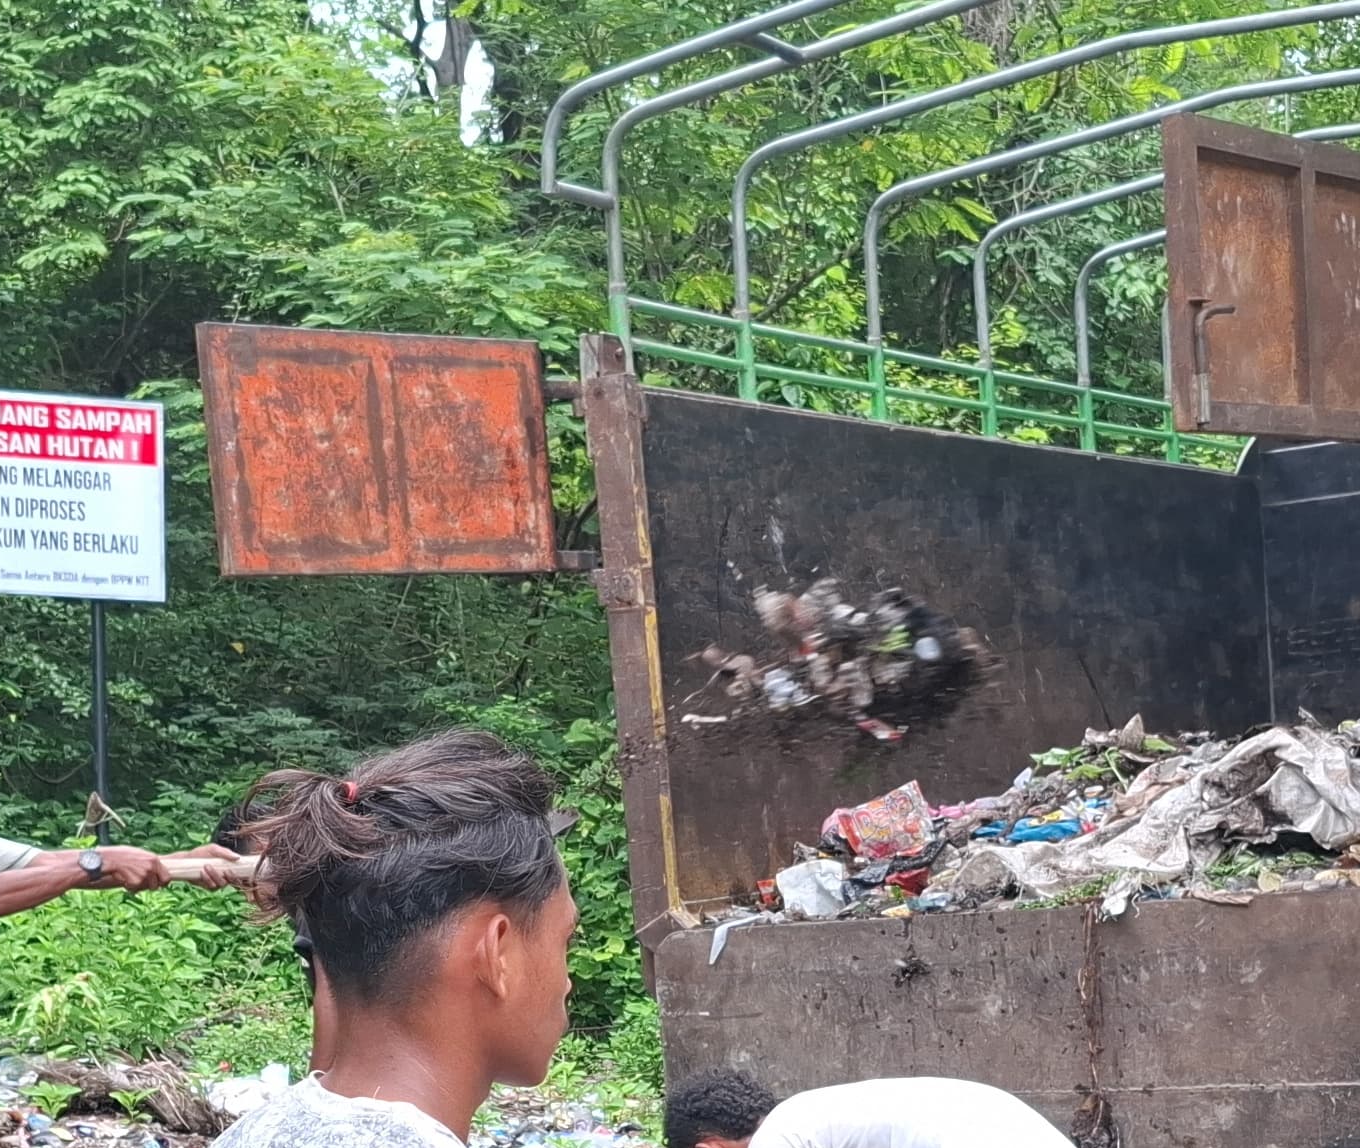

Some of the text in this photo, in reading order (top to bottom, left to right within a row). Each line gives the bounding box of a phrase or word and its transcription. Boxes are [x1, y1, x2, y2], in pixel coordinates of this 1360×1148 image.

[55, 407, 152, 435] SAMPAH
[47, 435, 124, 459] HUTAN
[23, 467, 112, 491] MELANGGAR
[15, 497, 86, 521] DIPROSES
[30, 529, 68, 551] YANG
[73, 532, 139, 555] BERLAKU
